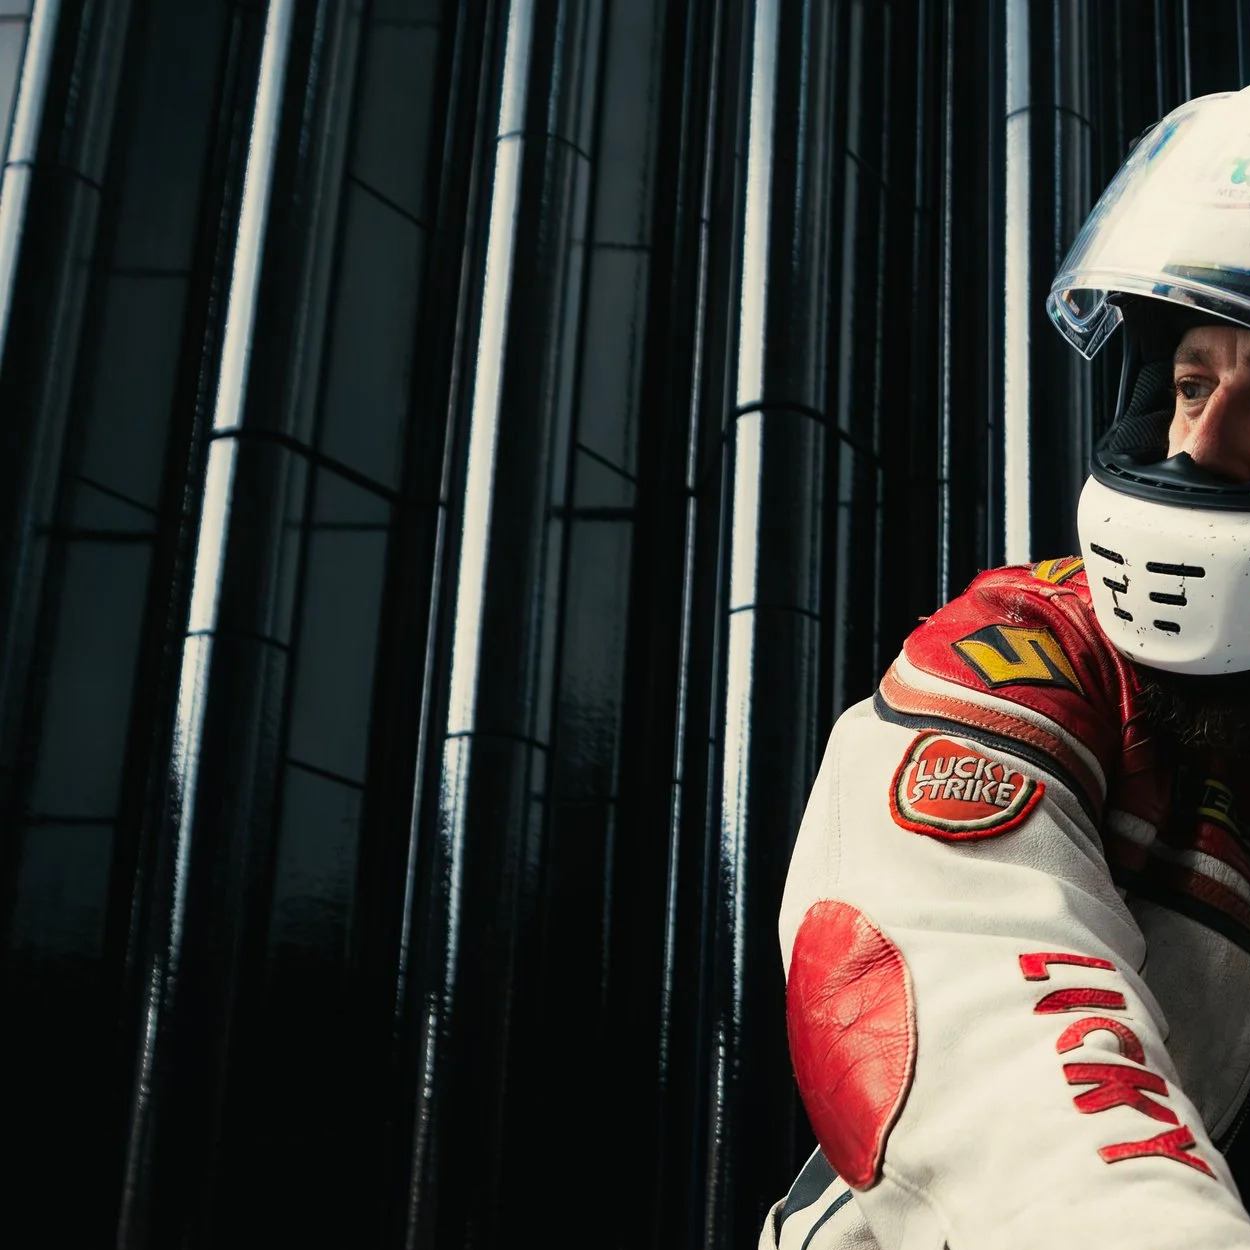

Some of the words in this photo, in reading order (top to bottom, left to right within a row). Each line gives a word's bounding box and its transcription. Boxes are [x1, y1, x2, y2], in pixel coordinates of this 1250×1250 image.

[916, 756, 1018, 783] LUCKY
[908, 779, 1018, 807] STRIKE
[1018, 952, 1218, 1180] LUCKY
